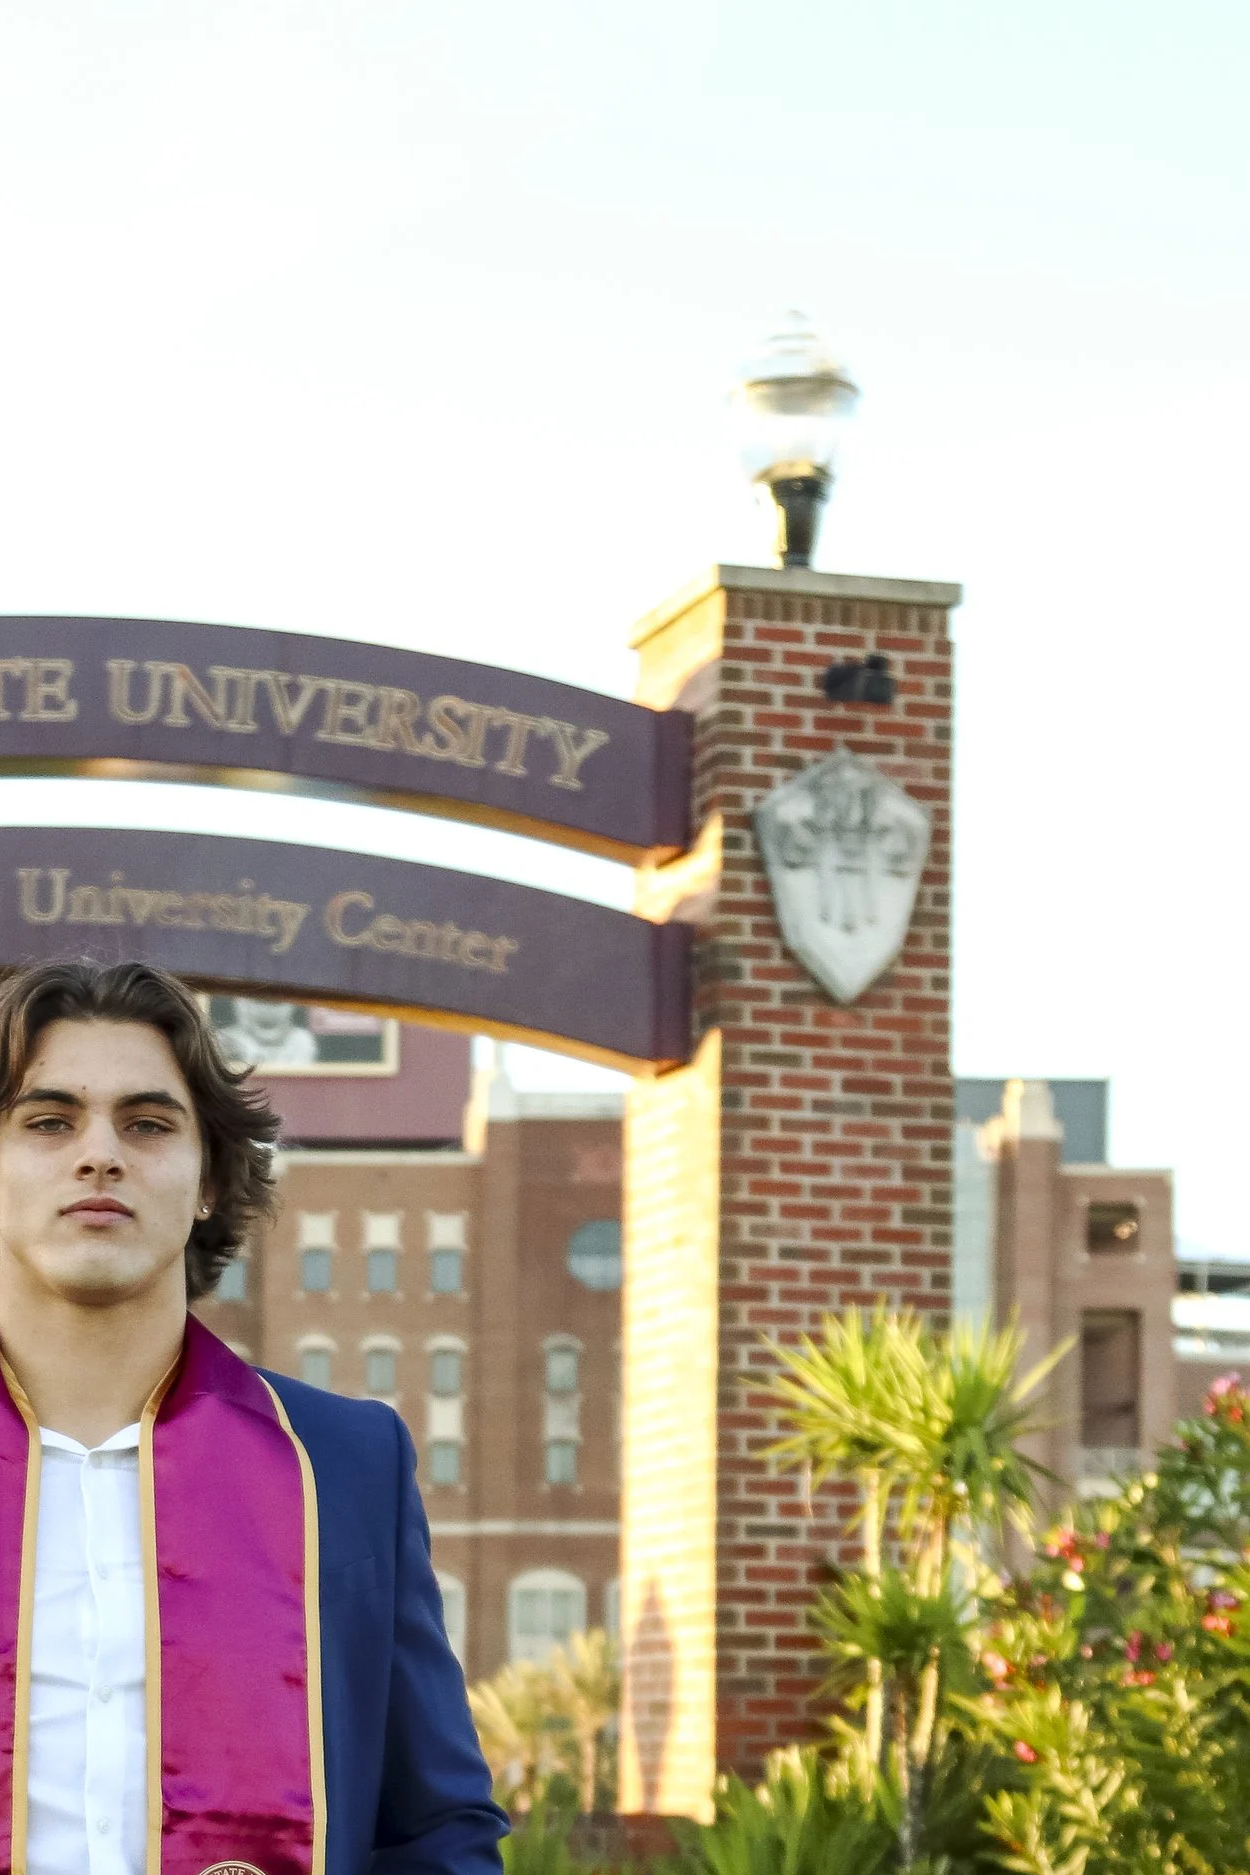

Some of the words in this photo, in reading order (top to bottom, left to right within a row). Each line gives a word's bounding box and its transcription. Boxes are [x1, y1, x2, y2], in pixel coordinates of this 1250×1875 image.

[105, 658, 610, 791] UNIVERSITY
[16, 867, 311, 956] University
[323, 891, 520, 975] Center
